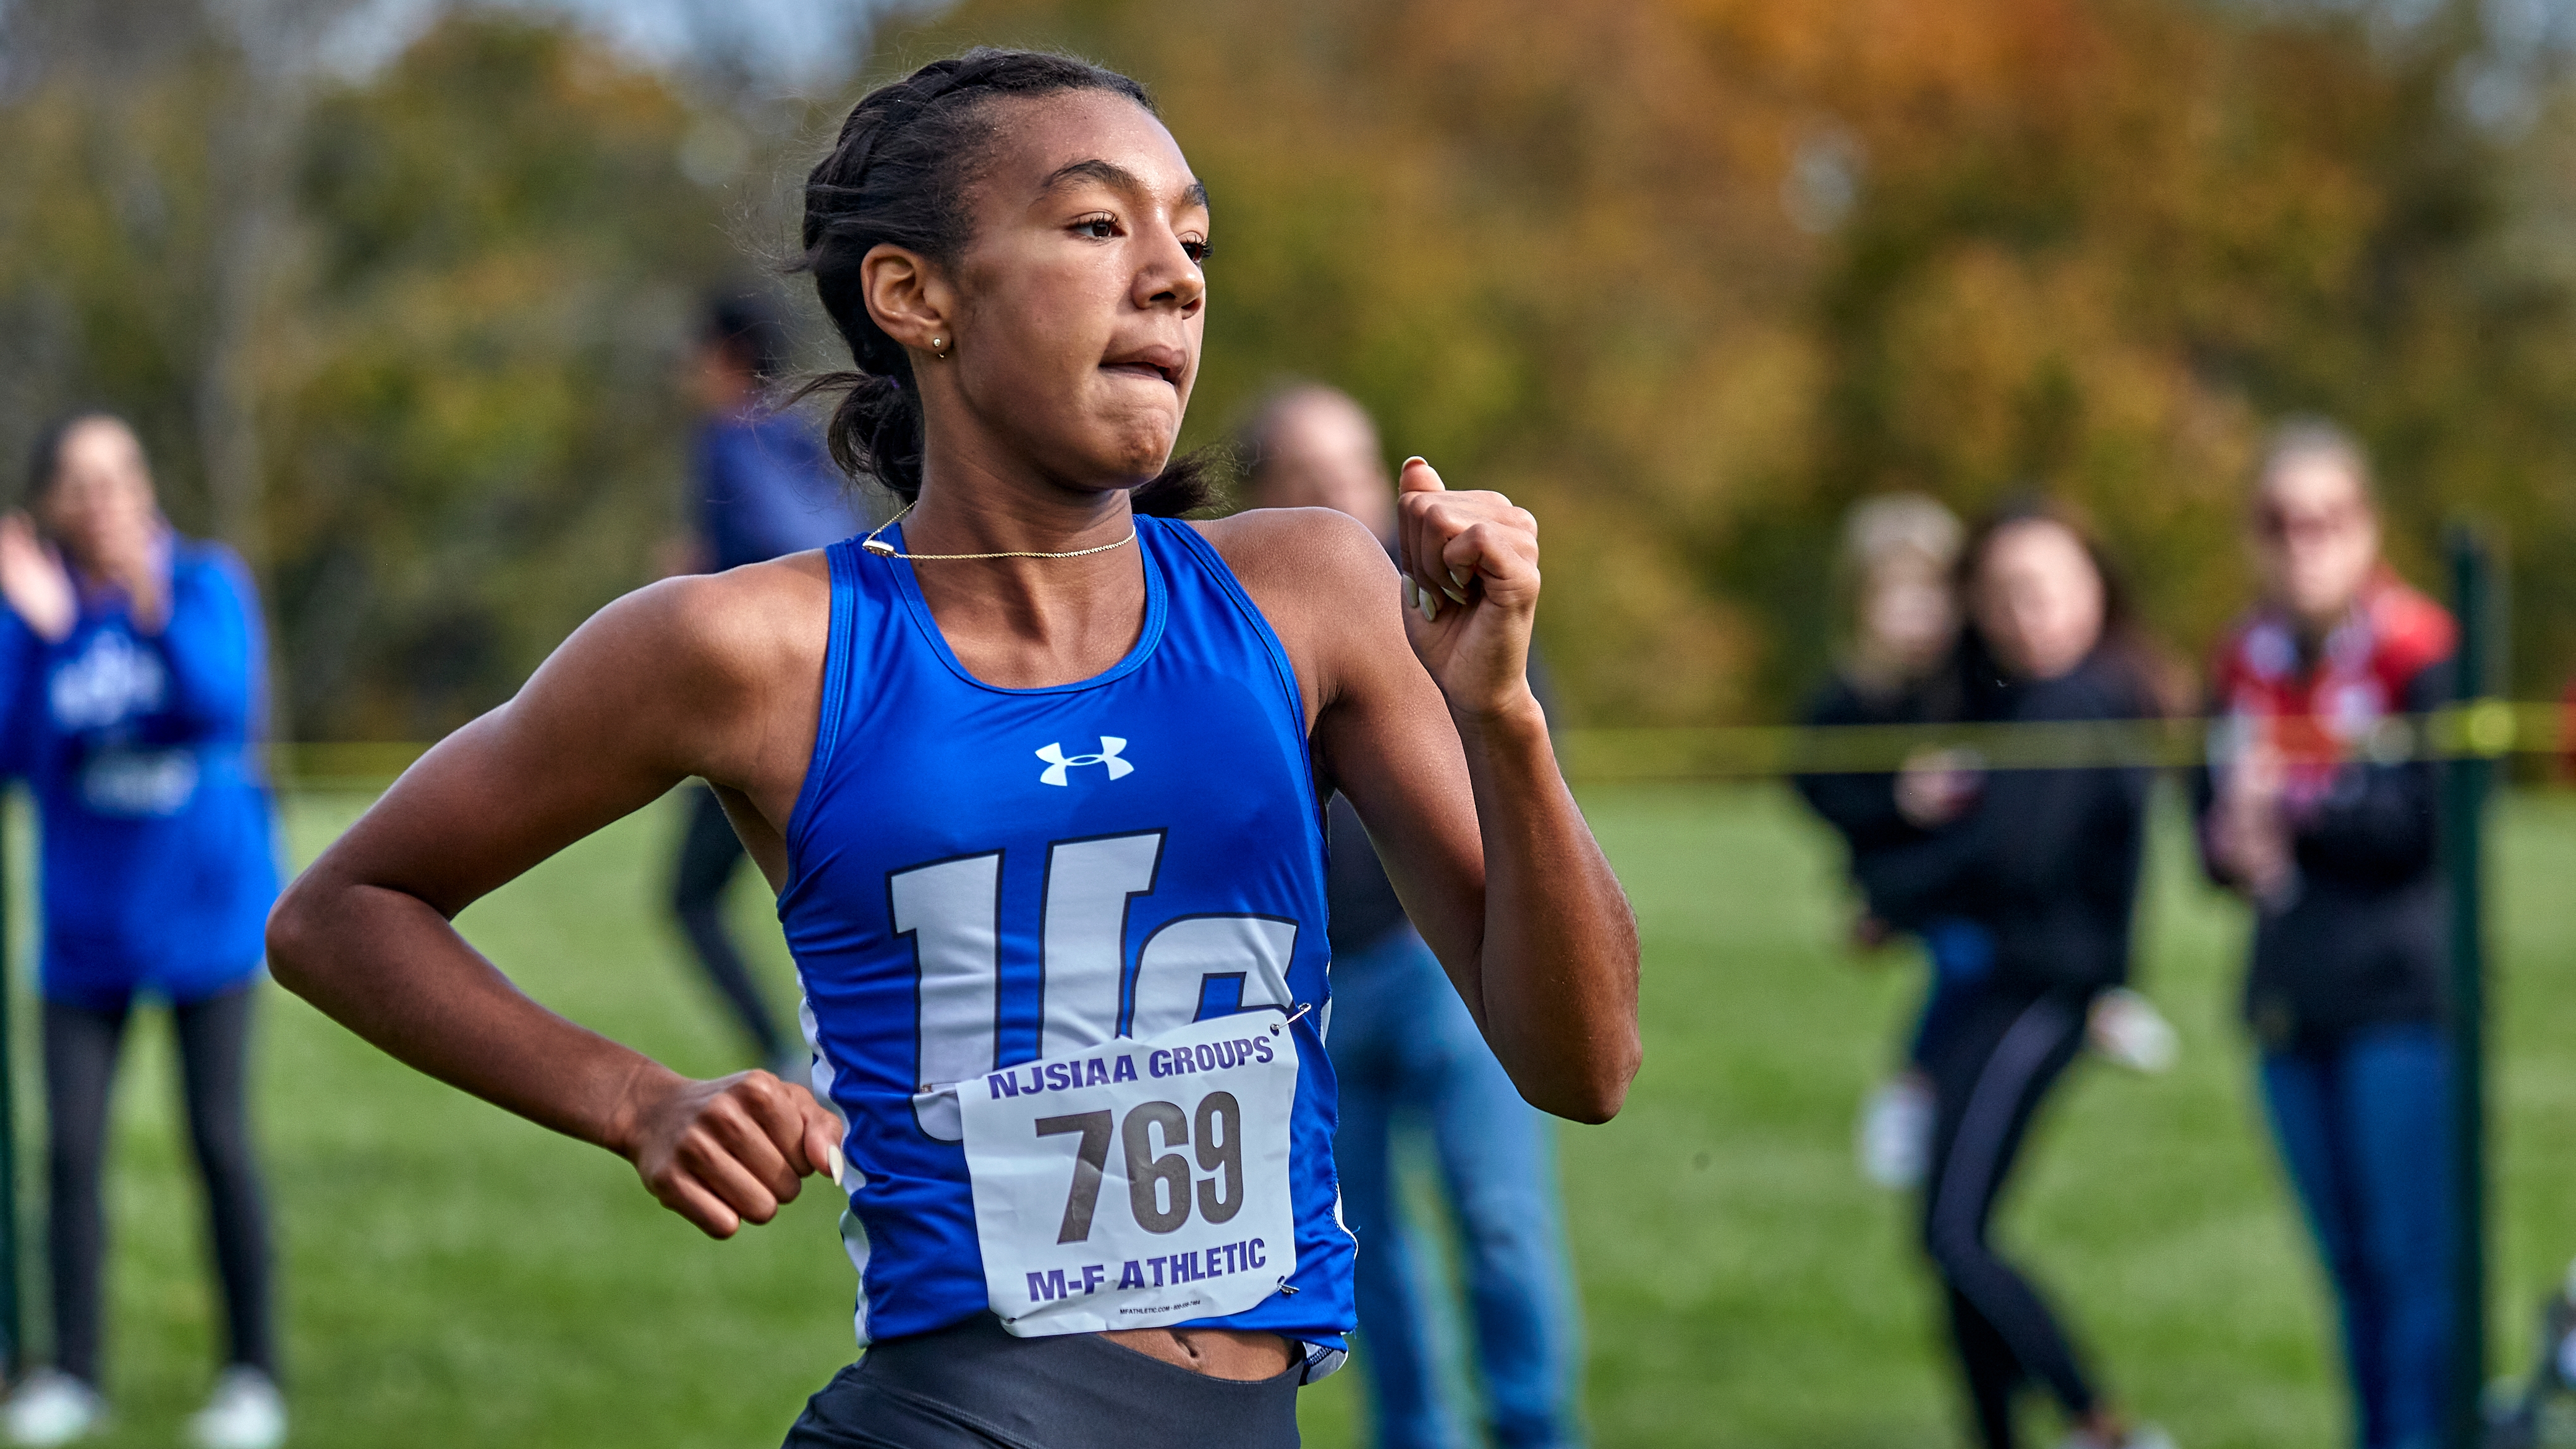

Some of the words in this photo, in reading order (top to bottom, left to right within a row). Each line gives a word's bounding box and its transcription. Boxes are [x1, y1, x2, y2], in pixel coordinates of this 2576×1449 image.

[987, 1055, 1138, 1100] NJSIAA
[1149, 1035, 1274, 1079] GROUPS
[1034, 1091, 1244, 1245] 769
[1026, 1264, 1105, 1302] M-F
[1116, 1238, 1266, 1290] ATHLETIC
[1120, 1306, 1170, 1314] MFATHLETIC.COM
